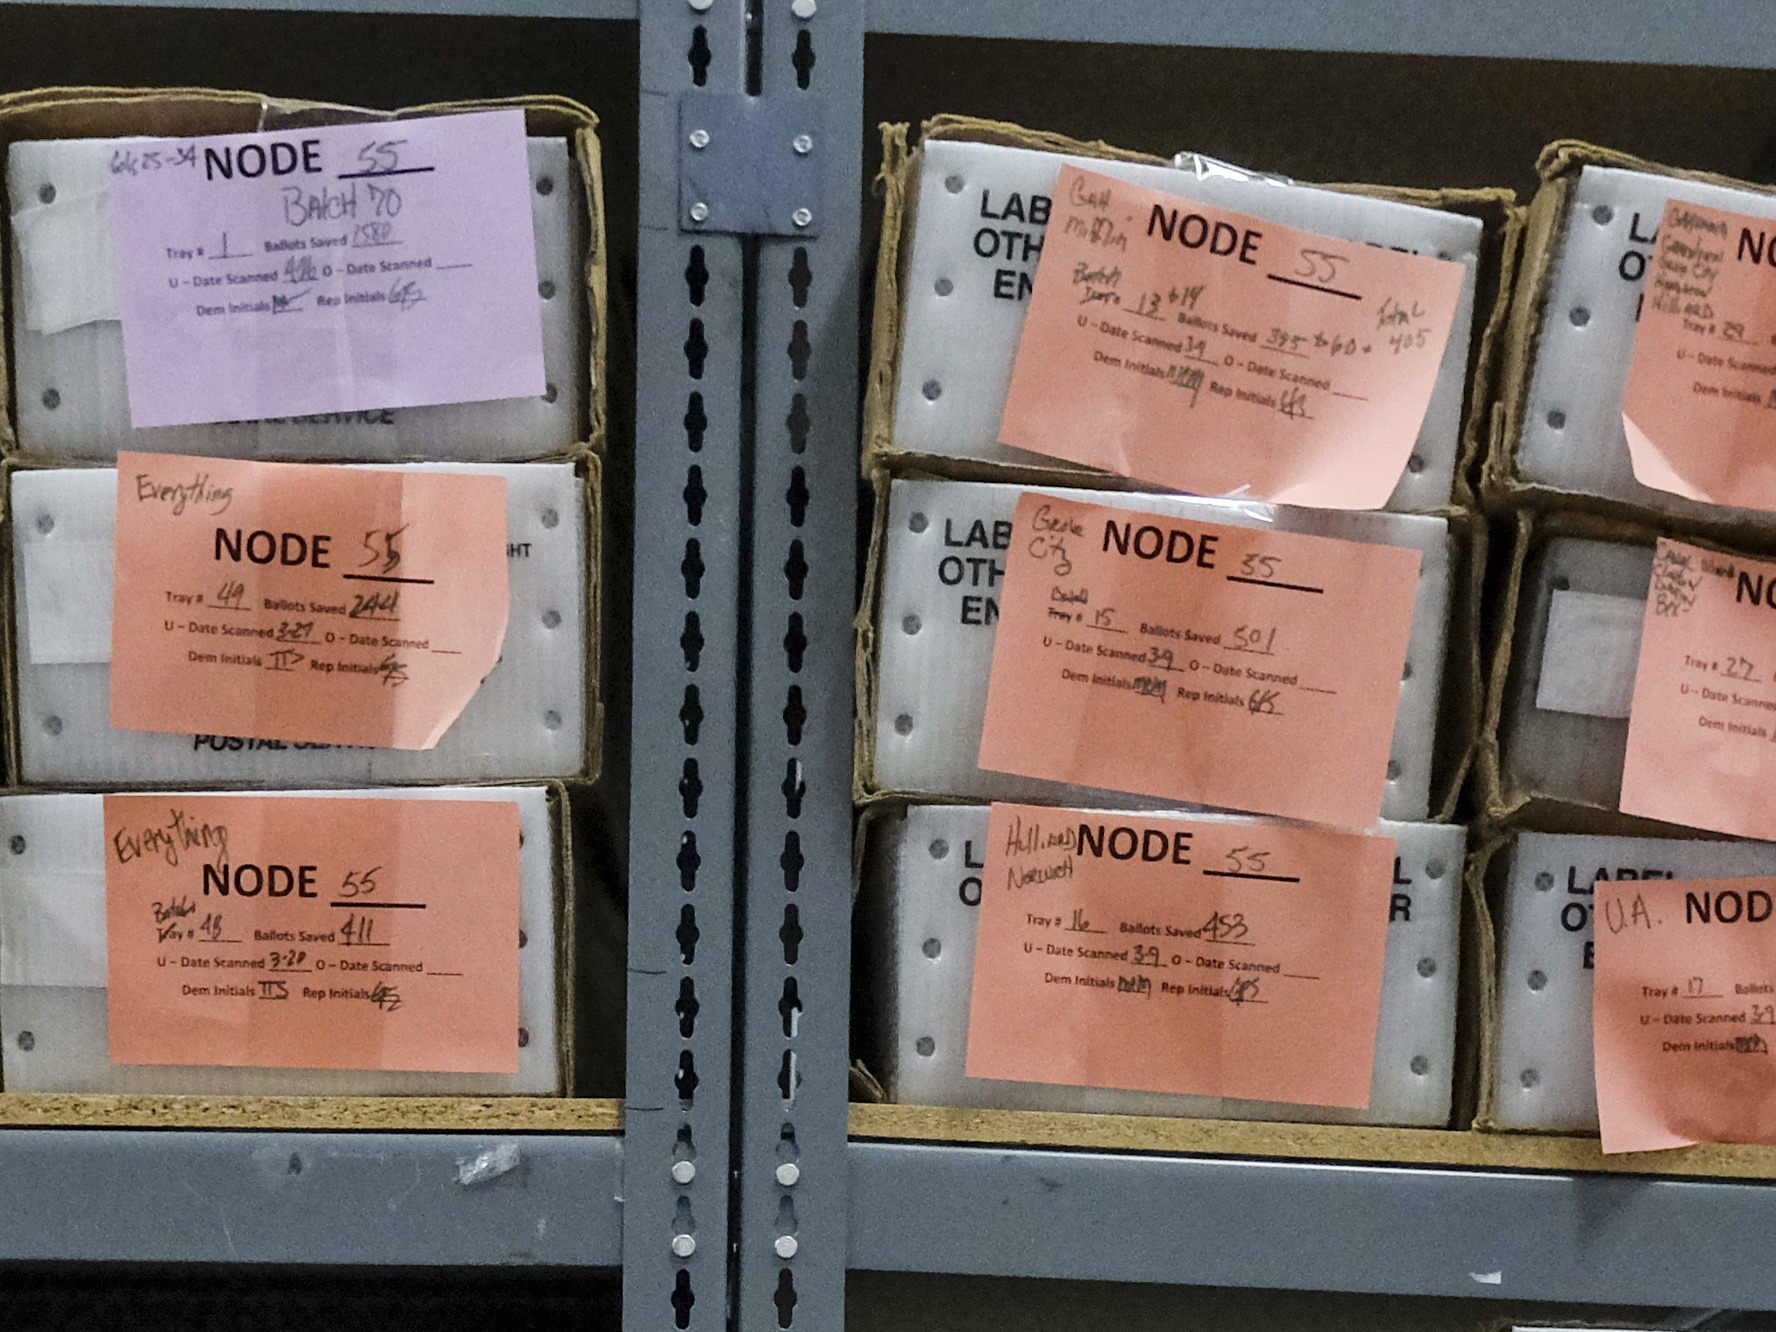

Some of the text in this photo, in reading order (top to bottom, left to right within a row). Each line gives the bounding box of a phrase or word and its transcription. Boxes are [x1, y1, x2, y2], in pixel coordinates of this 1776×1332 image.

[205, 140, 322, 180] NODE
[1148, 205, 1262, 264] NODE
[216, 528, 330, 568] NODE
[1103, 521, 1218, 568] NODE
[114, 808, 228, 866] Everything
[1077, 825, 1271, 873] NODE 55
[204, 864, 382, 897] NODE 55
[254, 914, 374, 945] Ballots Saved 411
